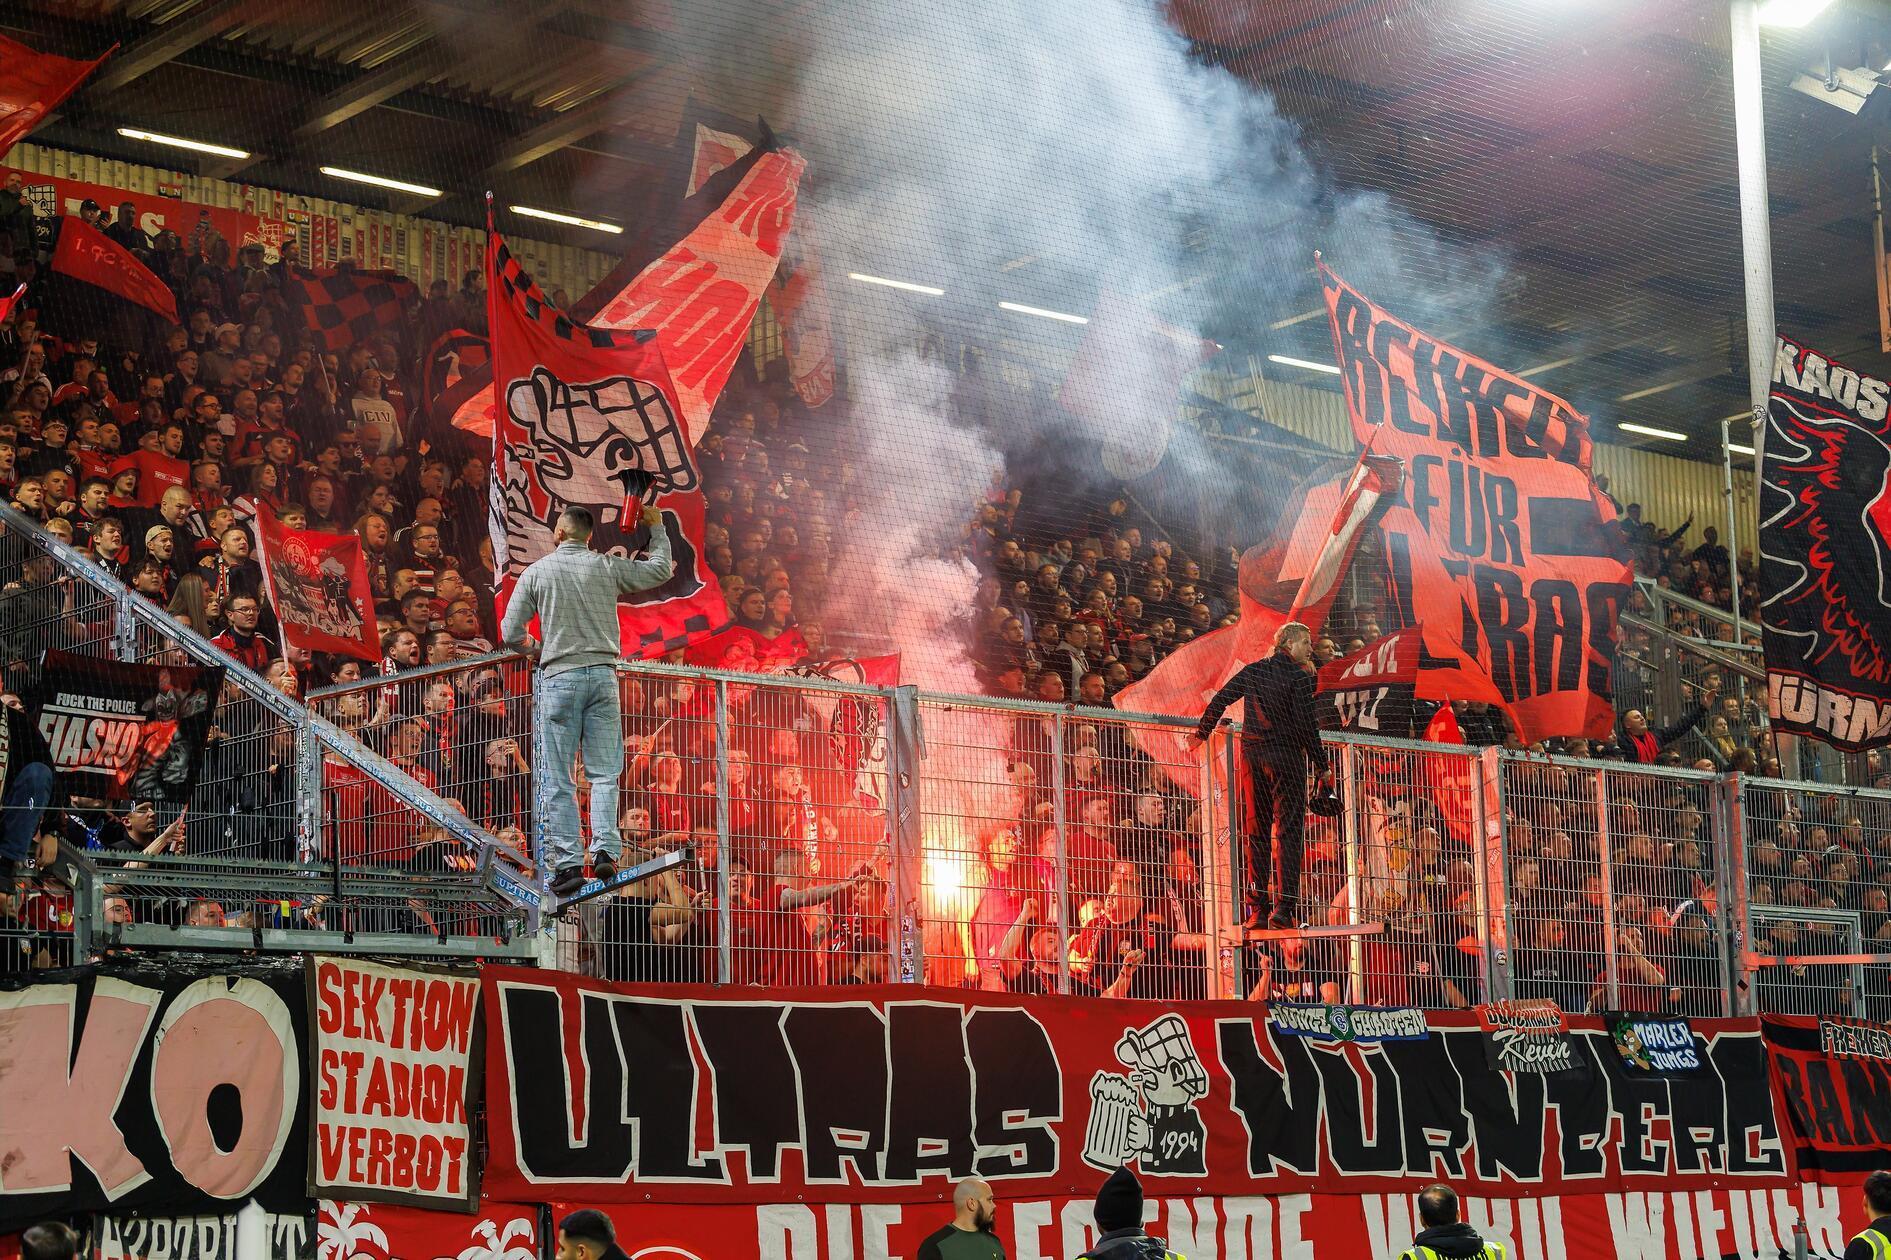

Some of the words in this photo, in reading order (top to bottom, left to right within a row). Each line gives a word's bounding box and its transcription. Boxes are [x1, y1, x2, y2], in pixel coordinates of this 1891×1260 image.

[1771, 336, 1891, 421] KAOS
[1412, 447, 1526, 568] FÜR
[55, 692, 85, 709] FUCK
[87, 696, 105, 712] THE
[106, 698, 137, 714] POLICE
[38, 712, 141, 767] FIASKO
[493, 872, 541, 907] SUPTRAS
[318, 962, 476, 1054] SEKTION
[1268, 1004, 1331, 1035] JUNGE
[1350, 1008, 1427, 1037] CHAOTEN
[1492, 1029, 1571, 1064] Kevin
[1633, 1022, 1695, 1049] MARLER
[1649, 1048, 1700, 1071] JUNGS
[319, 1049, 468, 1125] STADION
[496, 979, 1064, 1186] ULTRAS
[318, 1123, 466, 1194] VERBOT
[1159, 1130, 1199, 1160] 1994
